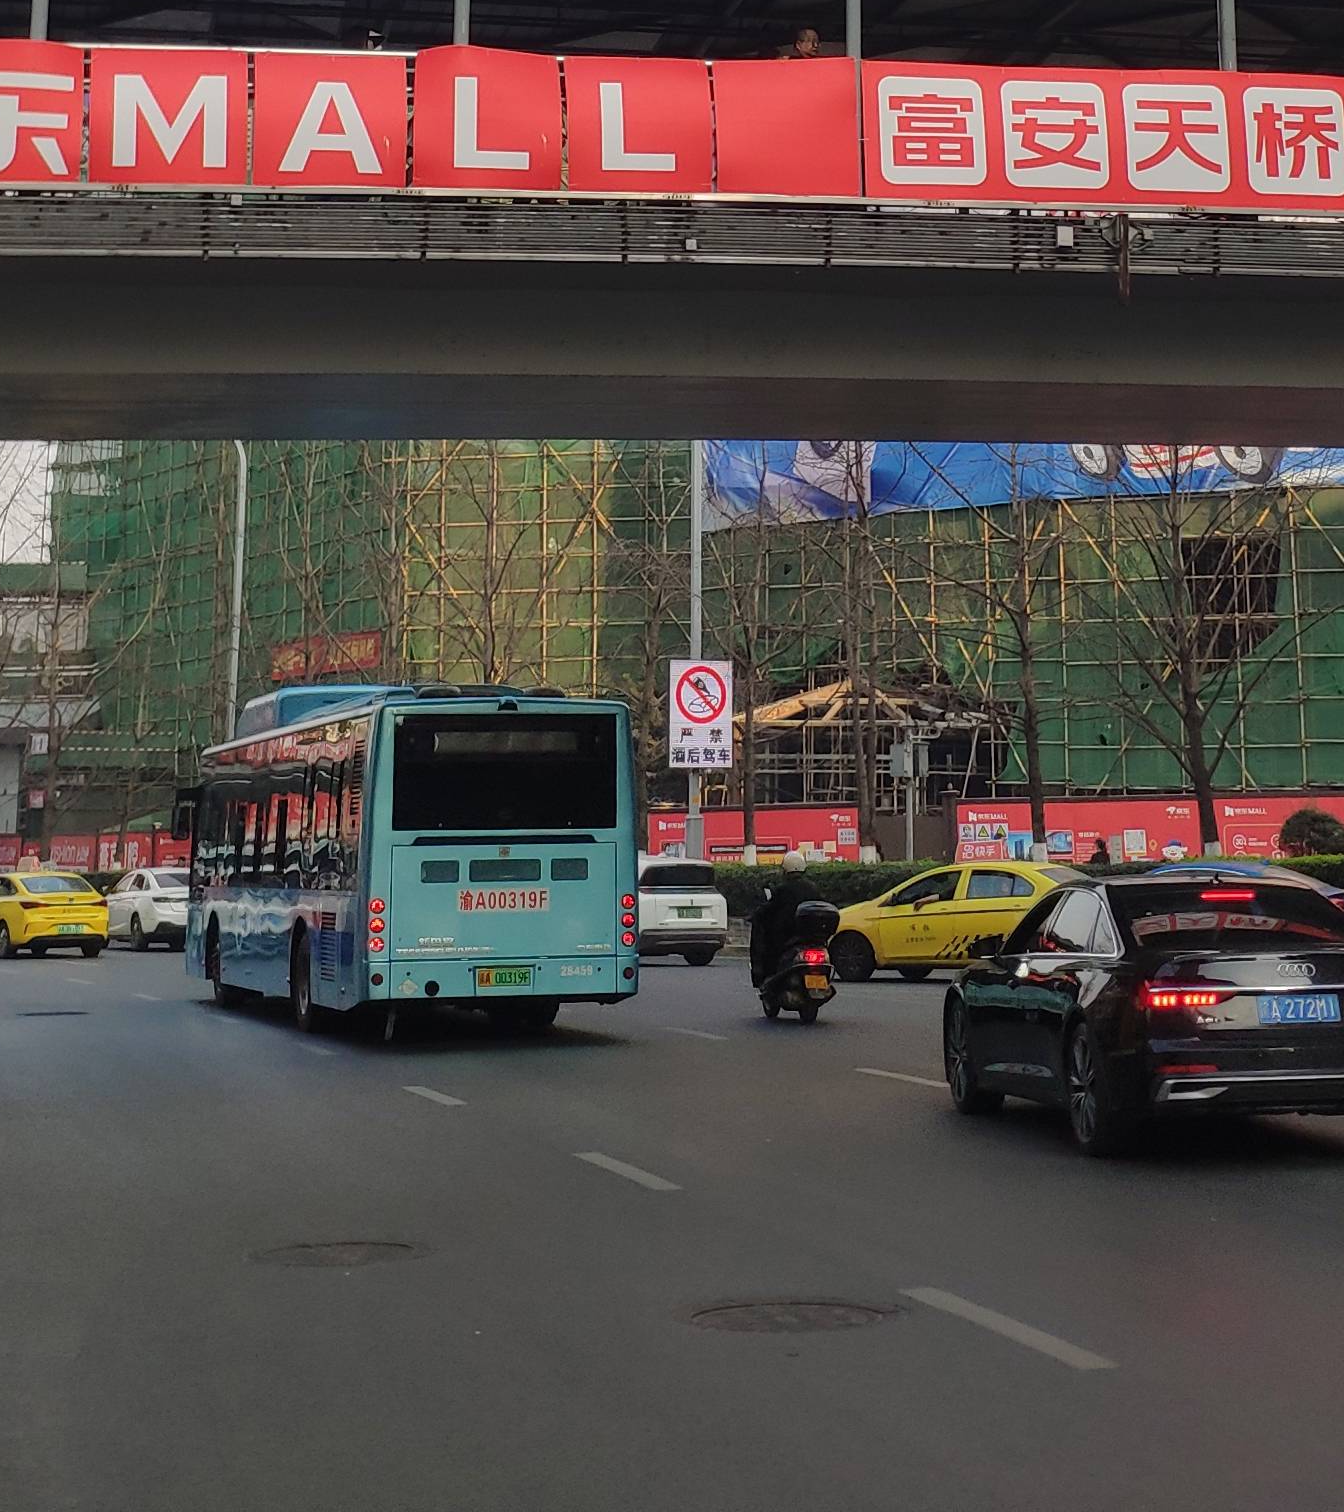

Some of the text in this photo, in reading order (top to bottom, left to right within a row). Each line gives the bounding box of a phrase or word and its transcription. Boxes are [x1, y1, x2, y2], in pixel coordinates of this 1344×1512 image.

[885, 90, 1342, 181] 富安天桥
[671, 747, 731, 765] 酒后驾车
[975, 845, 996, 857] 快手
[460, 890, 548, 912] 渝A00319F
